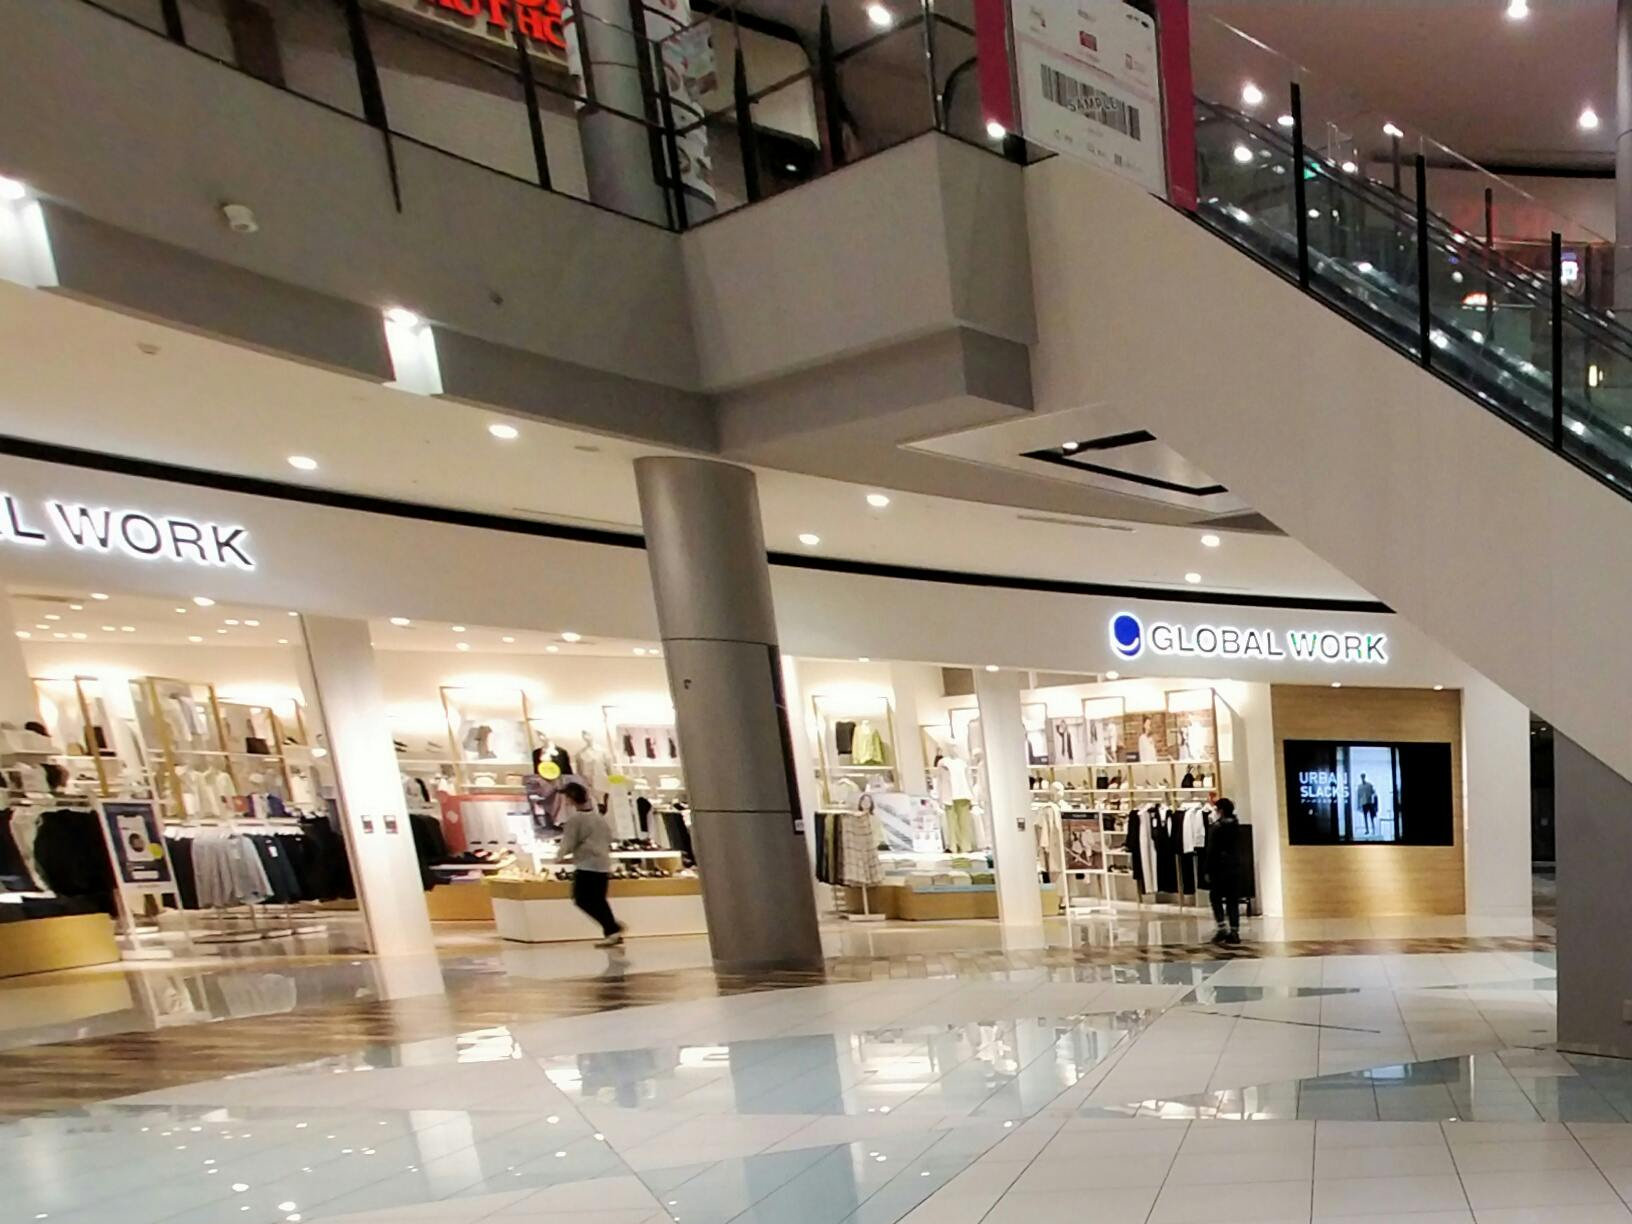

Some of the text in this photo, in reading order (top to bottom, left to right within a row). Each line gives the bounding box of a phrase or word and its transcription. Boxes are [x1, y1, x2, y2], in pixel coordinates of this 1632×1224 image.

[1067, 96, 1118, 112] SAMPLE
[0, 495, 254, 567] L WORK
[1151, 625, 1386, 660] GLOBAL WORK
[1299, 771, 1348, 785] URBAN
[1299, 785, 1350, 798] SLACKS
